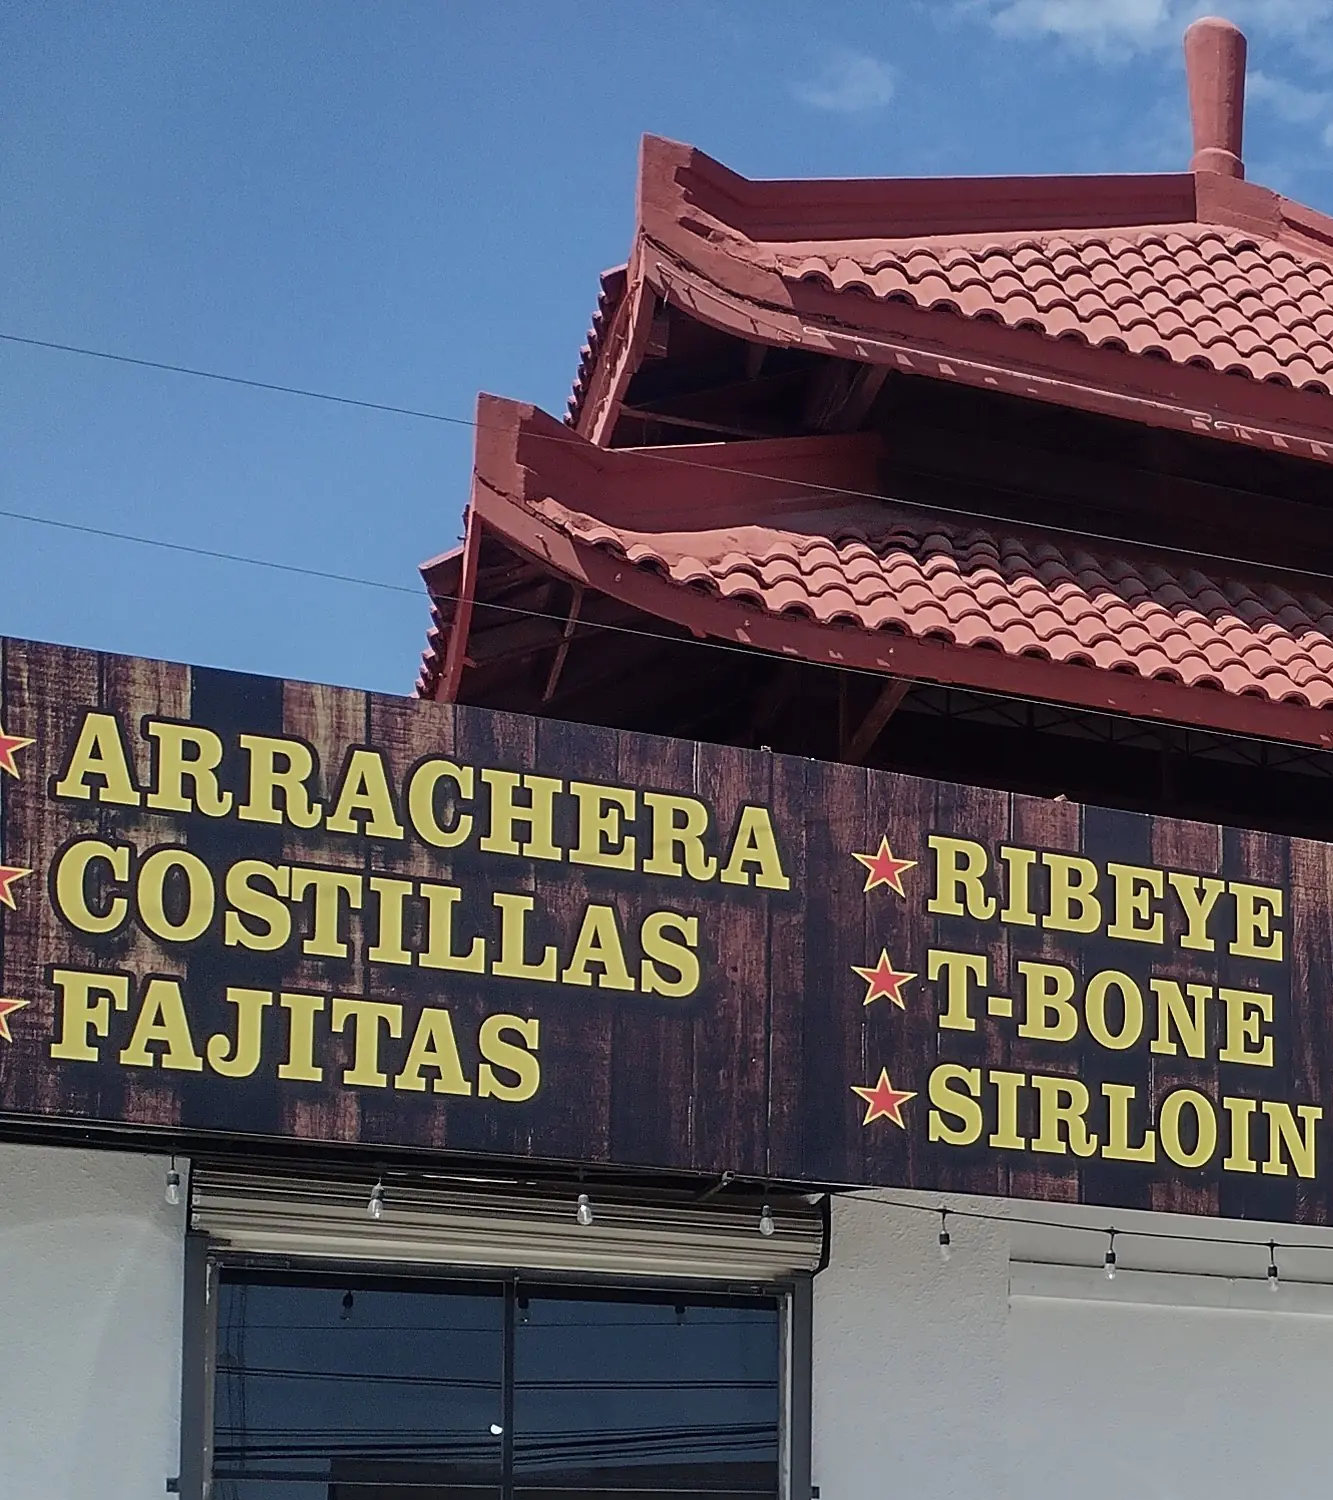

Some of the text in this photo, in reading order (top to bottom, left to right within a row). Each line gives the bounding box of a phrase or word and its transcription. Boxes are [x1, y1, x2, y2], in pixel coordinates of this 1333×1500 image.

[56, 713, 790, 890] ARRACHERA
[55, 839, 700, 998] COSTILLAS
[928, 835, 1284, 961] RIBEYE
[51, 969, 540, 1101] FAJITAS
[928, 949, 1274, 1067] T-BONE
[928, 1064, 1323, 1178] SIRLOIN
